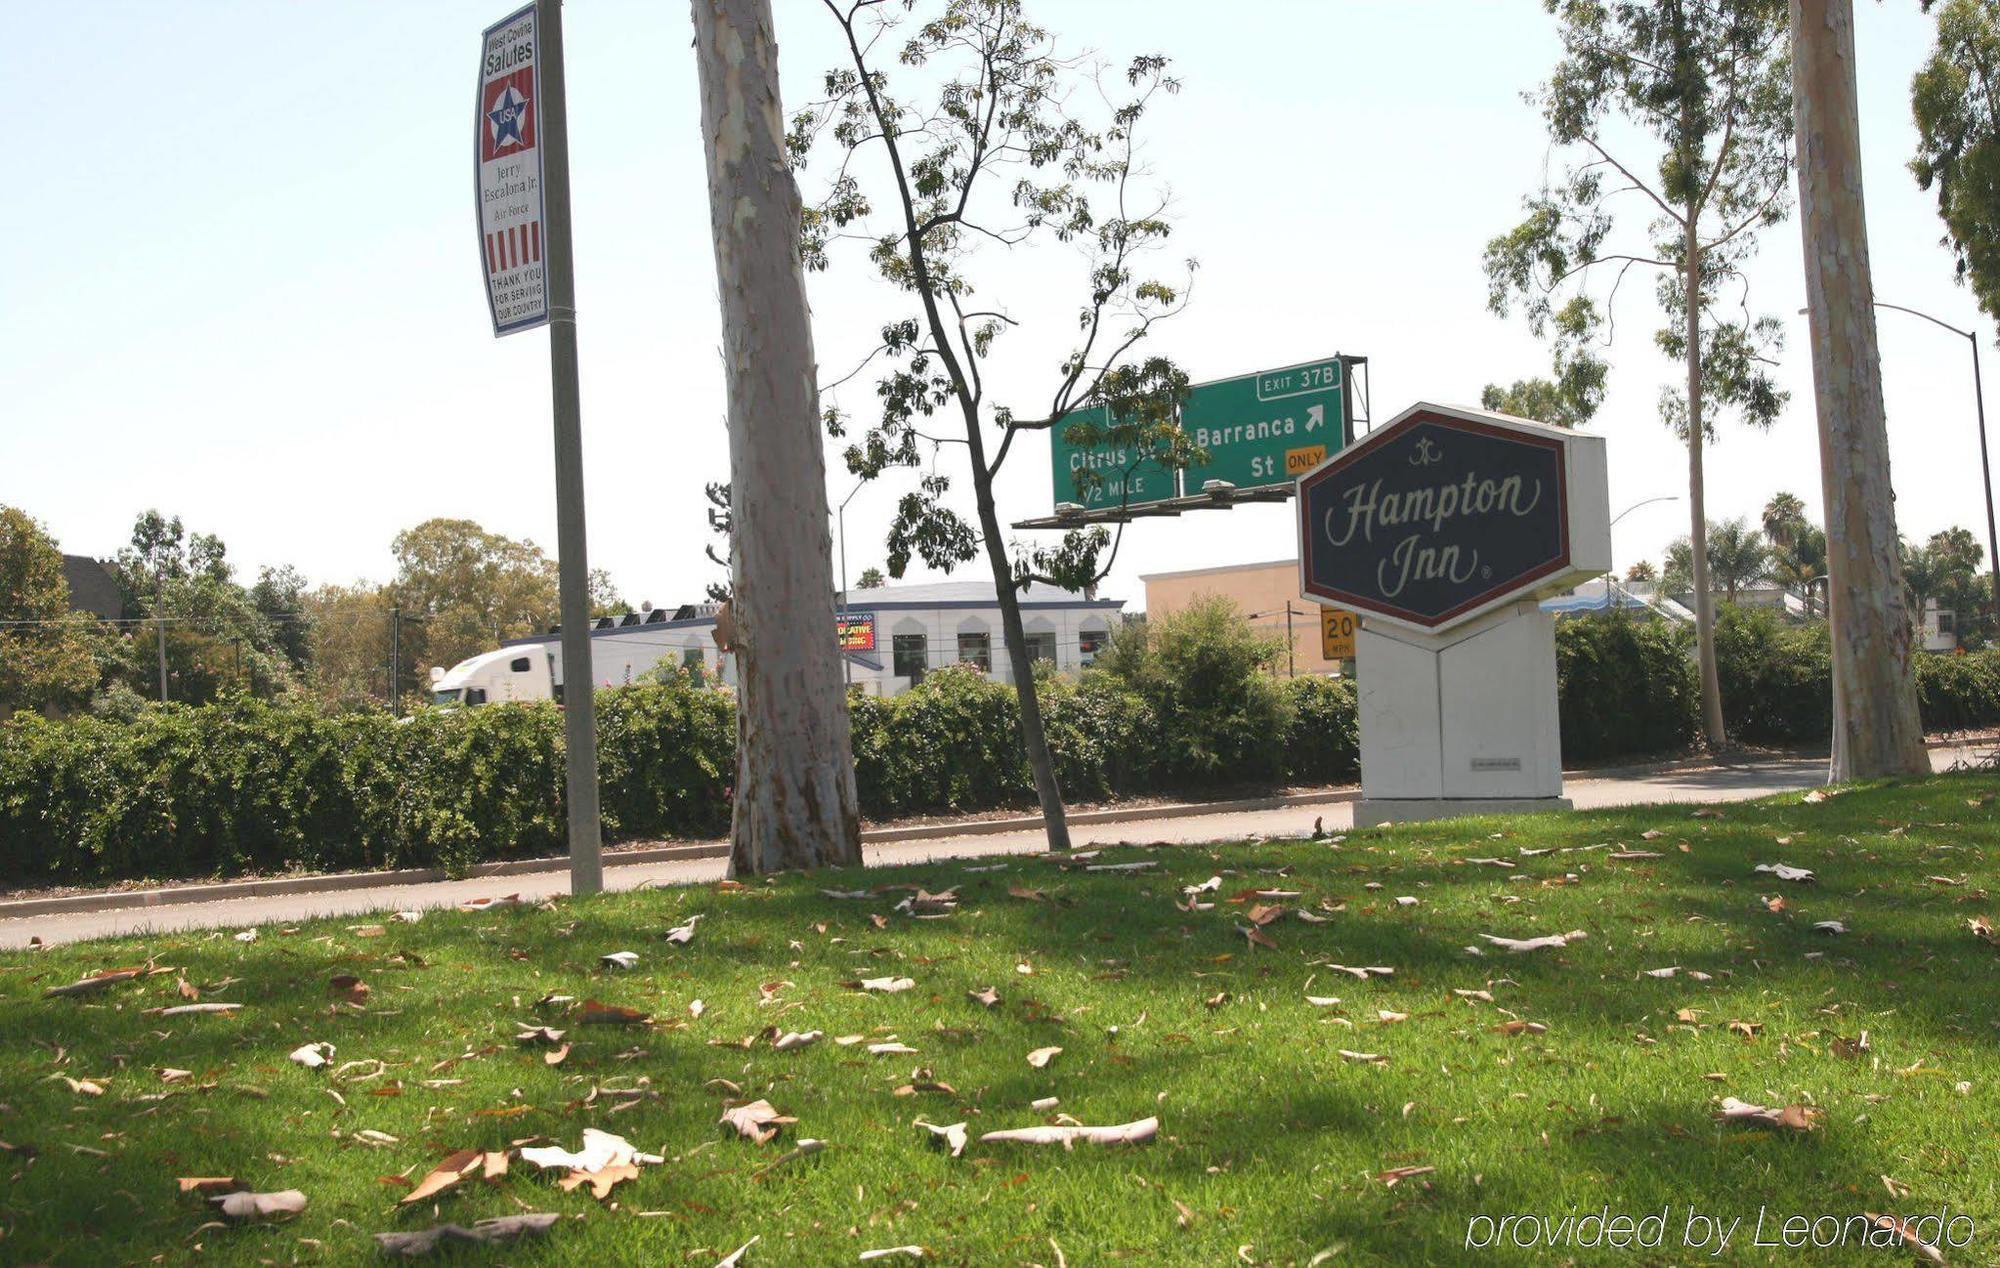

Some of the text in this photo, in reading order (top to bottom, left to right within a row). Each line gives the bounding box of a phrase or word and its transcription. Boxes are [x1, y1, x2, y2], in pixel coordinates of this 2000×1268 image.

[489, 22, 533, 52] West Covina
[486, 42, 533, 76] Salutes
[500, 108, 518, 125] USA
[497, 164, 521, 184] Jerry
[484, 176, 538, 203] Escalona Jr.
[495, 204, 529, 221] Air Force
[492, 268, 541, 290] THANK YOU
[495, 284, 542, 305] FOR SERVING
[498, 299, 542, 319] OUR COUNTRY
[1264, 366, 1334, 392] EXIT 37B
[1197, 416, 1296, 448] Barranca
[1069, 448, 1127, 472] Citrus
[1251, 451, 1323, 478] St ONLY
[1325, 471, 1542, 547] Hampton
[1377, 534, 1479, 598] Inn
[1327, 616, 1352, 638] 20
